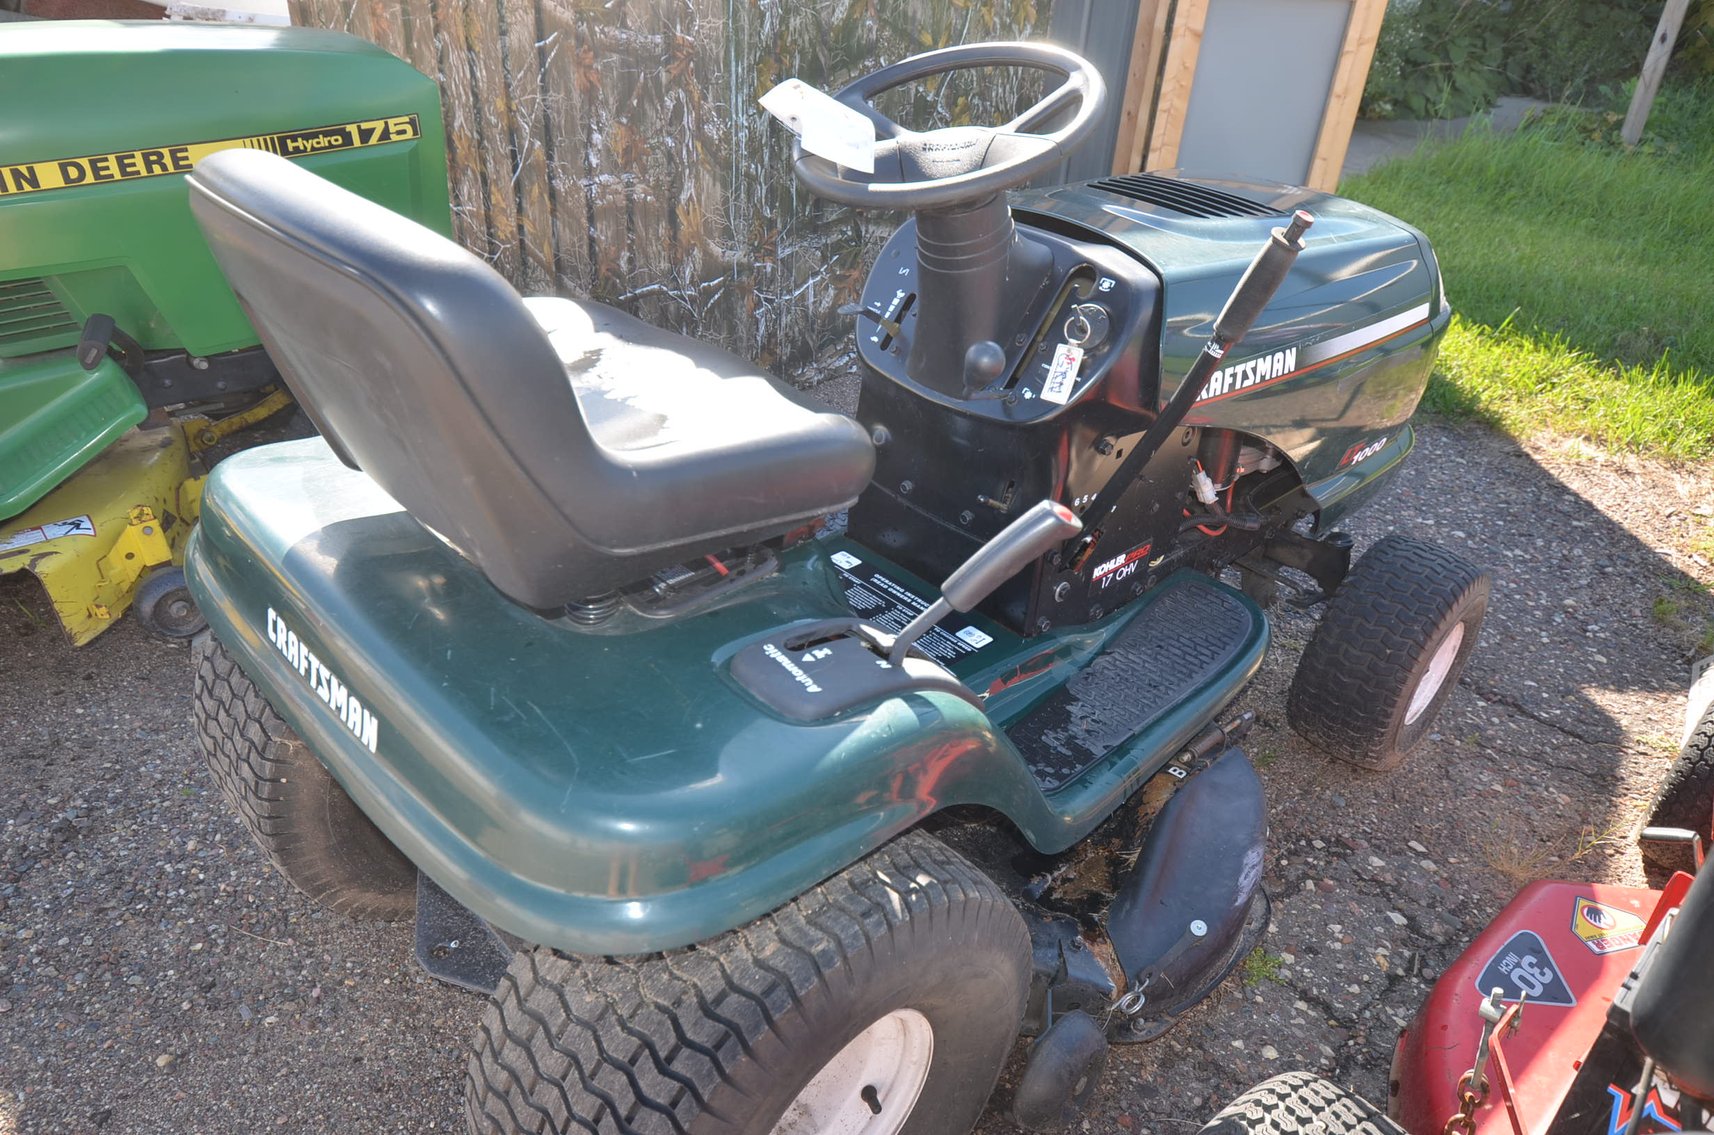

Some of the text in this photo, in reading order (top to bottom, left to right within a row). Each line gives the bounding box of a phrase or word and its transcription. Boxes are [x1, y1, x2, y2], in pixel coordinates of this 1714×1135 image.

[57, 147, 194, 186] DEERE
[286, 134, 343, 152] Hydro
[345, 116, 414, 147] 175
[1074, 497, 1081, 507] 6
[1082, 494, 1089, 504] 5
[1092, 553, 1126, 579] KOHLER
[1101, 559, 1139, 589] 17 OHV
[873, 573, 905, 593] OPERATING
[267, 607, 378, 754] CRAFTSMAN
[763, 643, 823, 693] Automatic
[1168, 766, 1187, 779] B
[1497, 952, 1520, 975] INCH
[1510, 954, 1554, 998] 30
